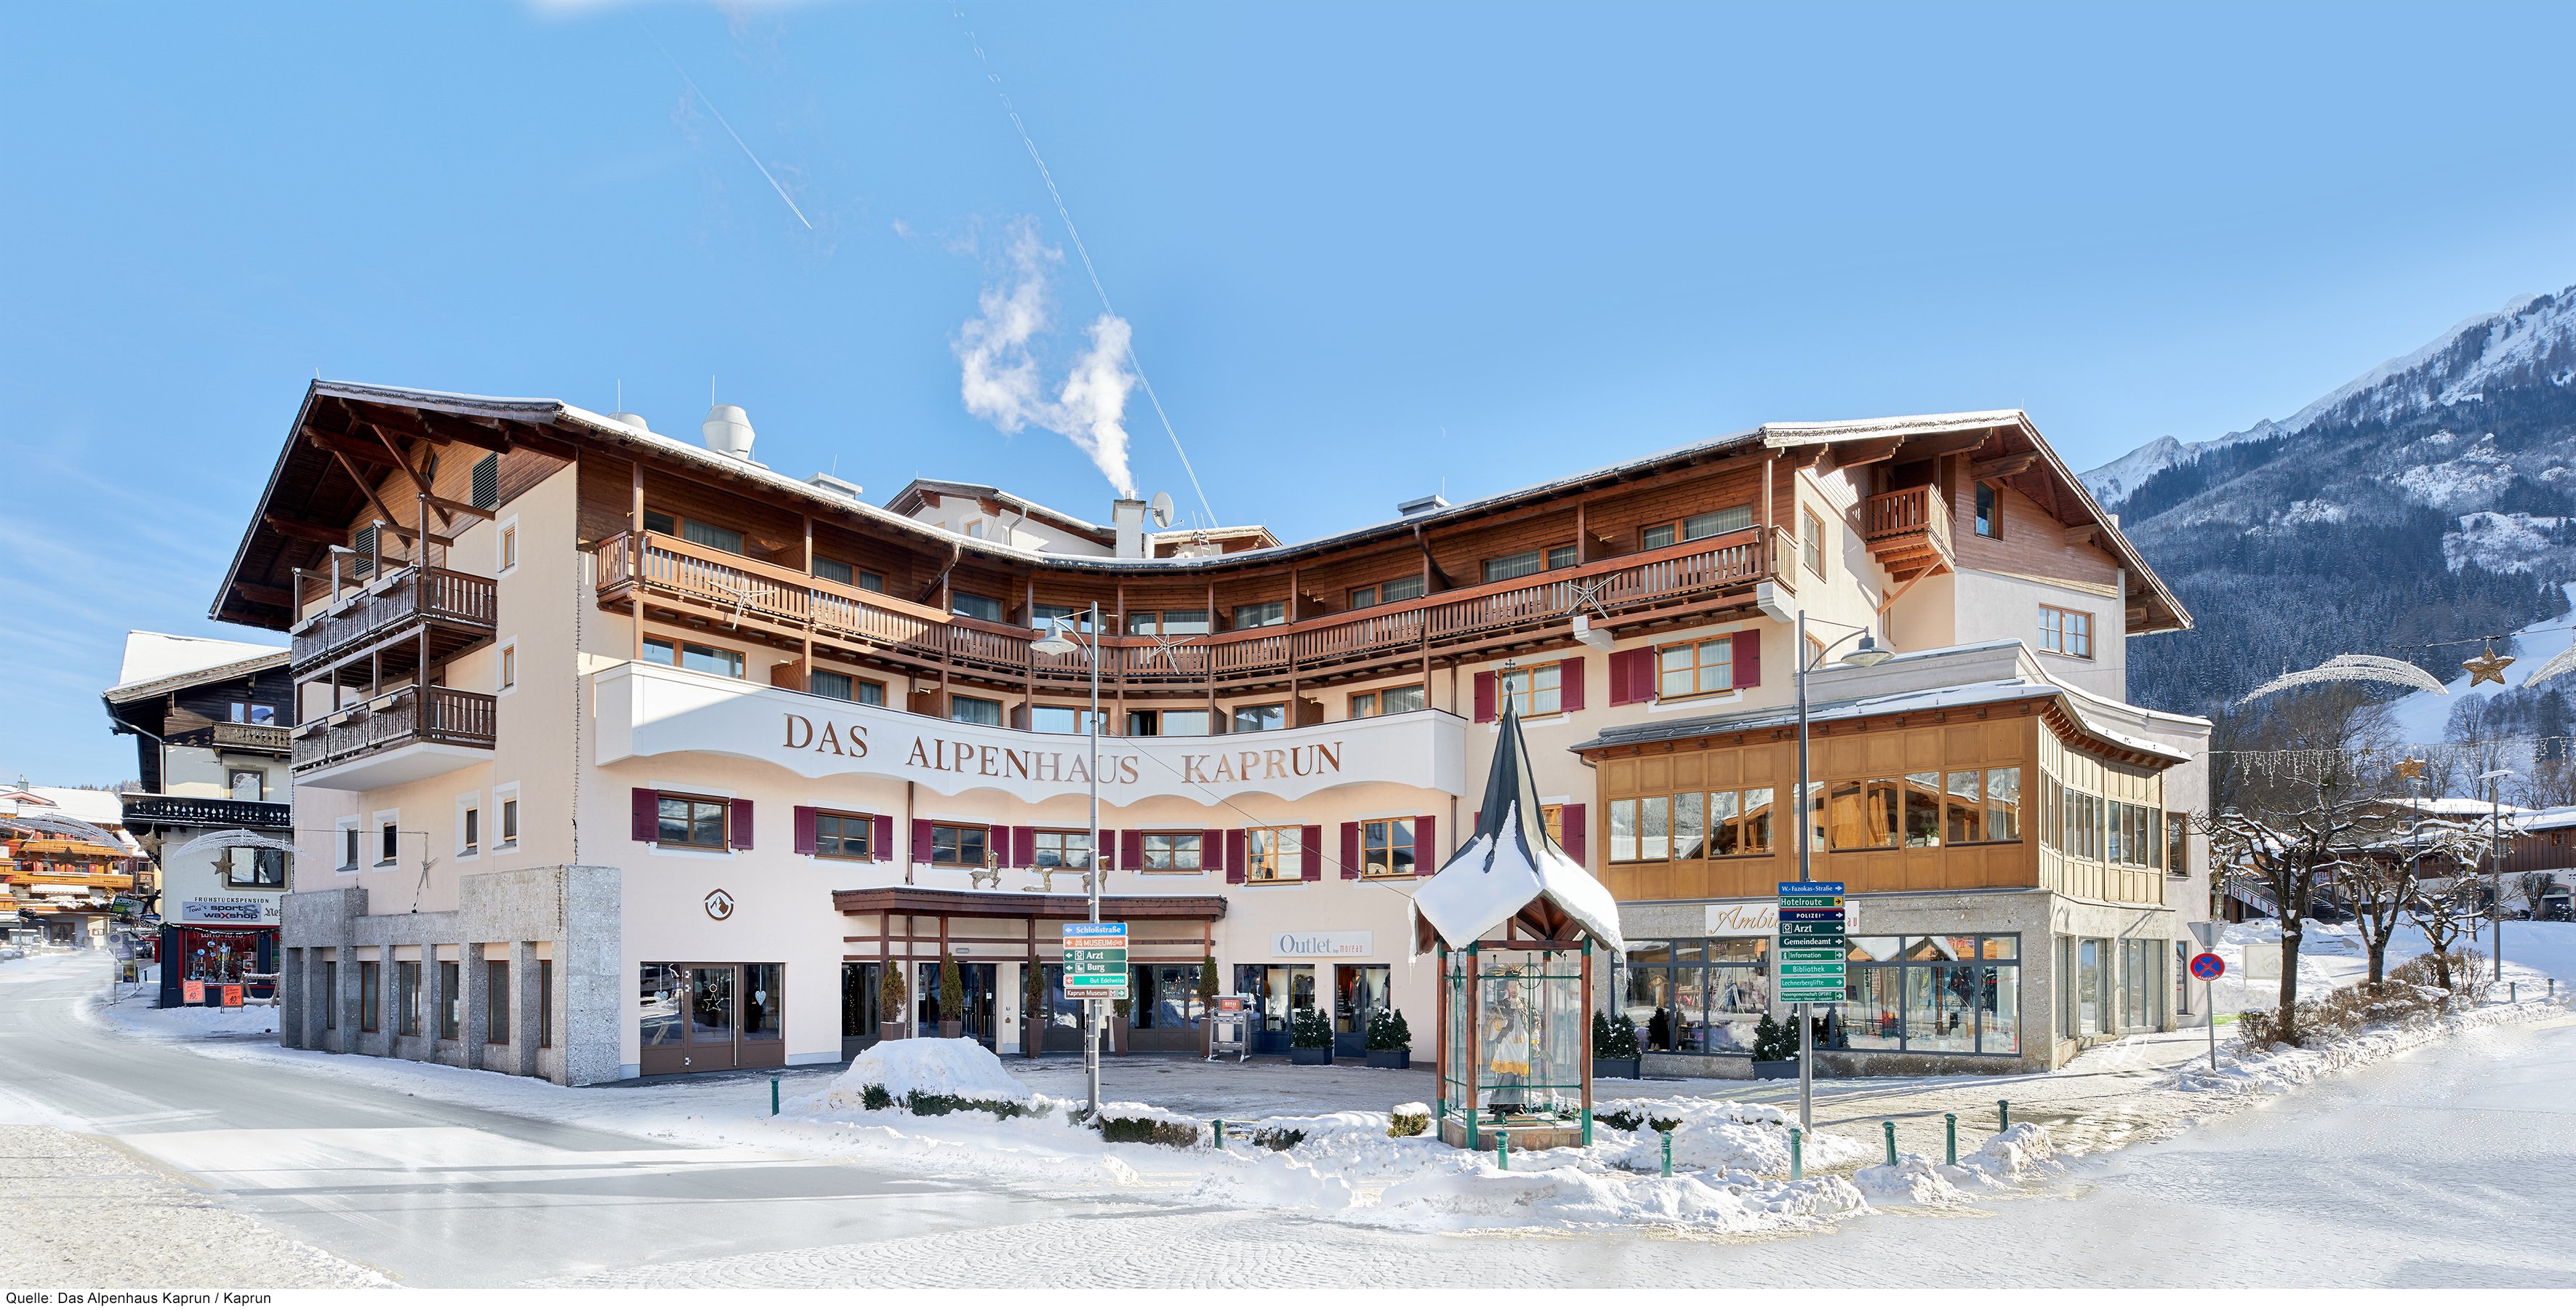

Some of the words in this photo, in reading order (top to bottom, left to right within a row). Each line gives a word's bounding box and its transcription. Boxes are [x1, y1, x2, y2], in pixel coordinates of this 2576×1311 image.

[783, 713, 868, 758] DAS
[905, 736, 1139, 784] ALPENHAUS
[1181, 741, 1343, 783] KAPRUN
[186, 904, 207, 913] Toni's
[1794, 924, 1813, 933] Arzt
[1280, 934, 1332, 953] Outlet
[1086, 951, 1104, 959] Arzt
[1087, 963, 1105, 972] Burg
